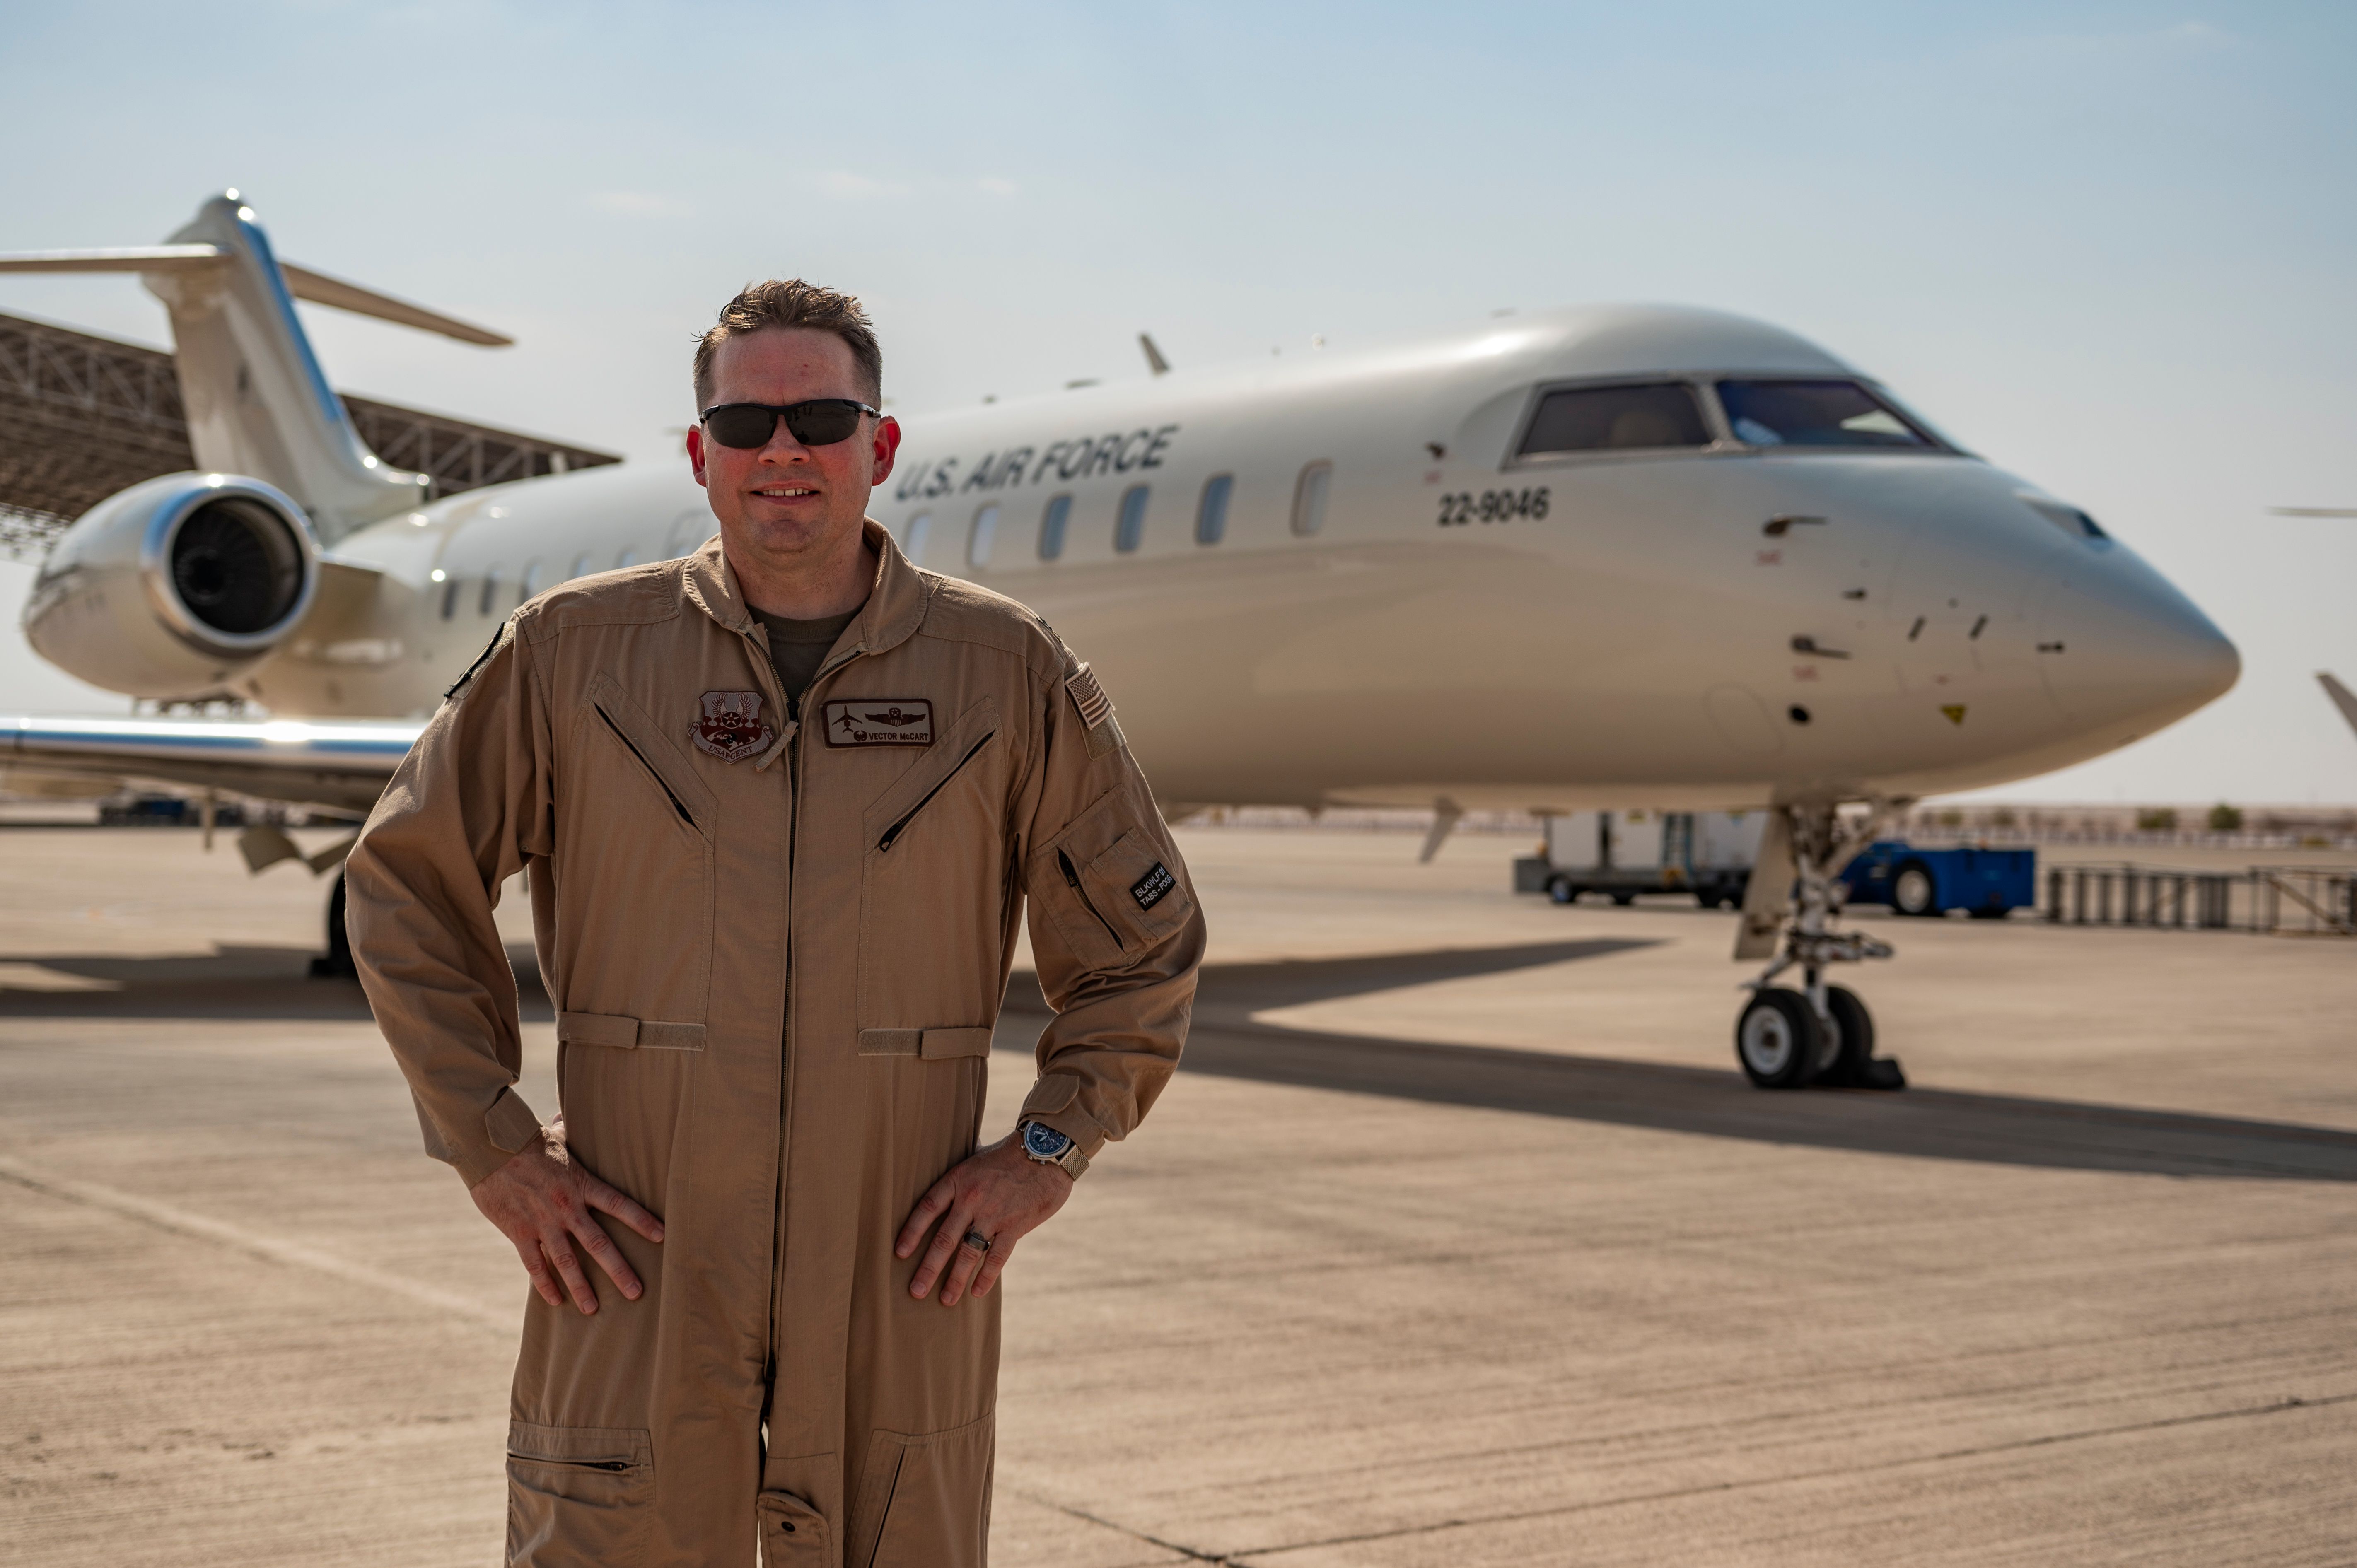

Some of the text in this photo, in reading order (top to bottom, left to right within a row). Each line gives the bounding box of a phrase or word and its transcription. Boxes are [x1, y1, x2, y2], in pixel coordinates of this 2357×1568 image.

[895, 425, 1178, 500] U.S. AIR FORCE
[1438, 487, 1549, 526] 22-9046
[708, 745, 752, 759] USAFCENT
[899, 732, 928, 741] McCART
[1135, 866, 1166, 897] BLKWLF 01
[1140, 890, 1158, 905] TABS
[1159, 874, 1172, 890] FOGG
